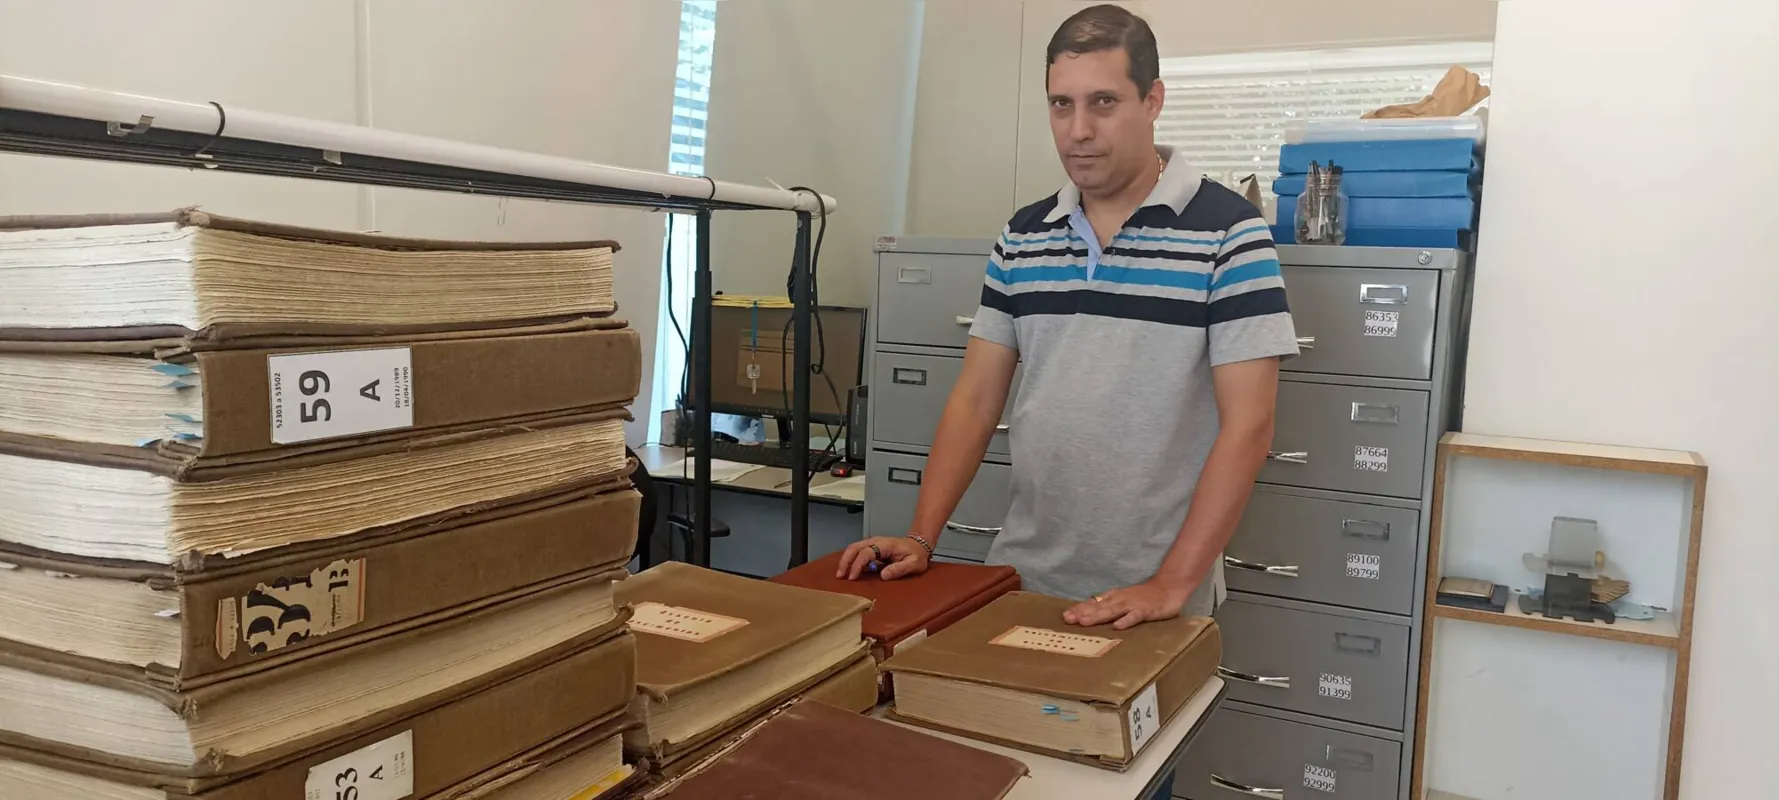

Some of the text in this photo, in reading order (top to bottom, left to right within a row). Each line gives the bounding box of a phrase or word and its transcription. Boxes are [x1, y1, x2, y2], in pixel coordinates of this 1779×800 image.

[1363, 325, 1396, 337] 86999
[274, 372, 282, 397] 53502
[359, 378, 381, 402] A
[393, 367, 401, 409] 20/12/1989
[298, 369, 332, 423] 59
[1355, 446, 1387, 458] 87664
[1354, 460, 1387, 470] 88299
[1347, 554, 1379, 566] 89100
[1347, 567, 1379, 579] 89799
[1319, 686, 1351, 699] 91399
[1145, 706, 1152, 718] A
[1133, 707, 1142, 741] 58
[368, 764, 383, 780] A
[1305, 764, 1336, 780] 92200
[335, 767, 358, 800] 53
[1304, 777, 1335, 791] 92999
